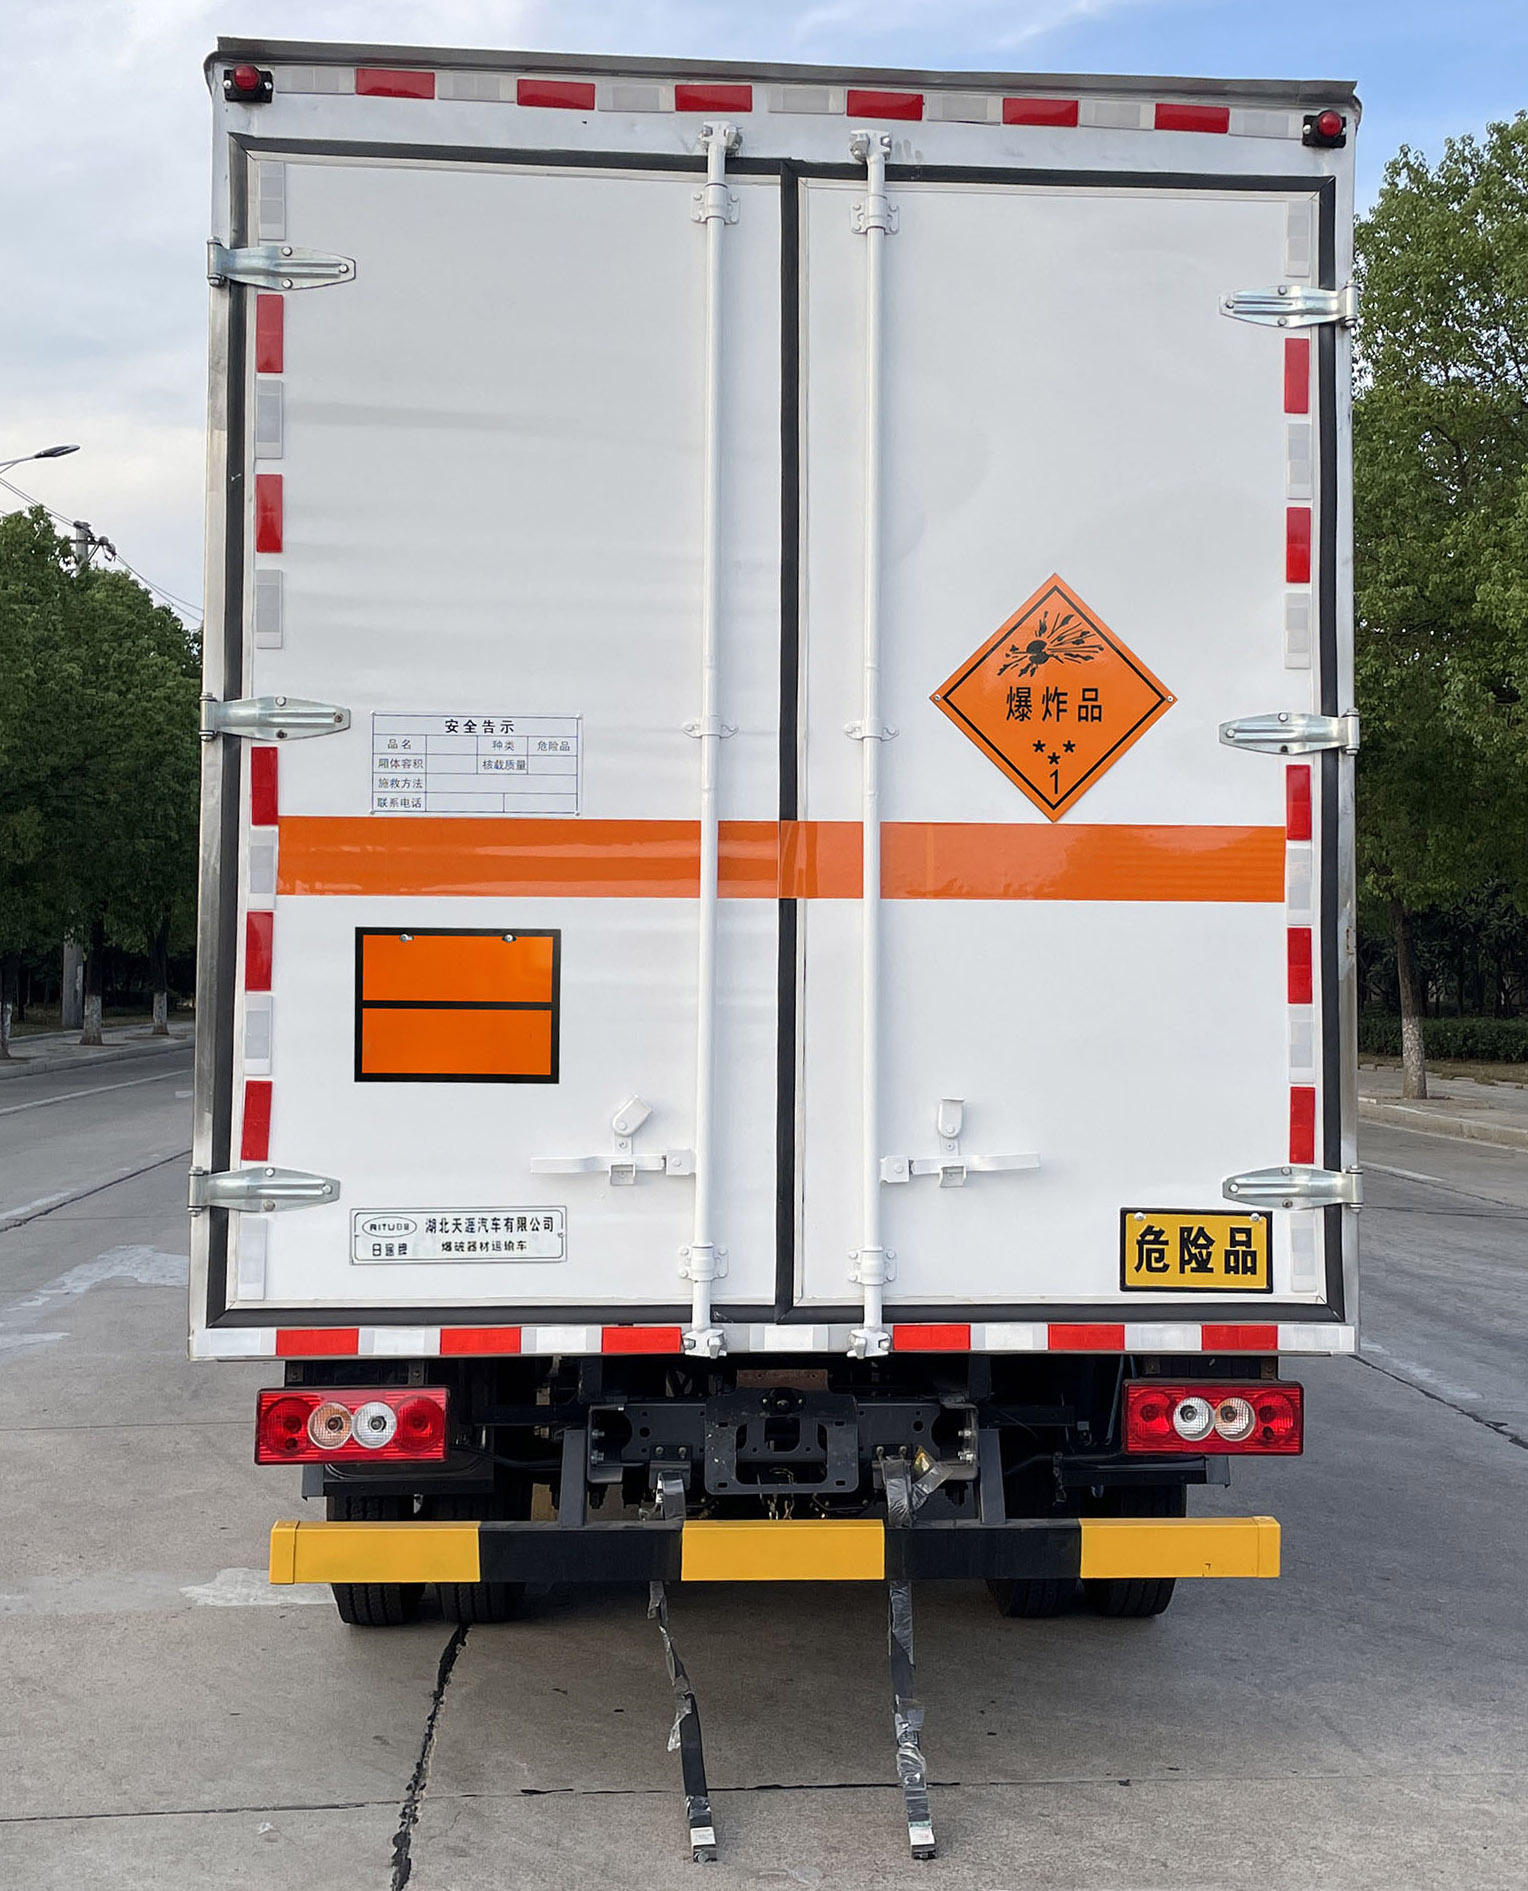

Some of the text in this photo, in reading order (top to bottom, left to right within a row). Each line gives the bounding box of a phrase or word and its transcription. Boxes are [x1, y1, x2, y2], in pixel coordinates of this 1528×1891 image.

[1005, 686, 1103, 723] 爆炸品
[445, 719, 515, 734] 安全告示
[387, 738, 412, 750] 品名
[492, 740, 515, 751] 种类
[537, 740, 571, 752] 危险品
[482, 759, 527, 771] 核载质量
[378, 777, 423, 789] 施救方法
[1049, 769, 1059, 795] 1
[377, 797, 422, 809] 联系电话
[1134, 1224, 1257, 1275] 危险品
